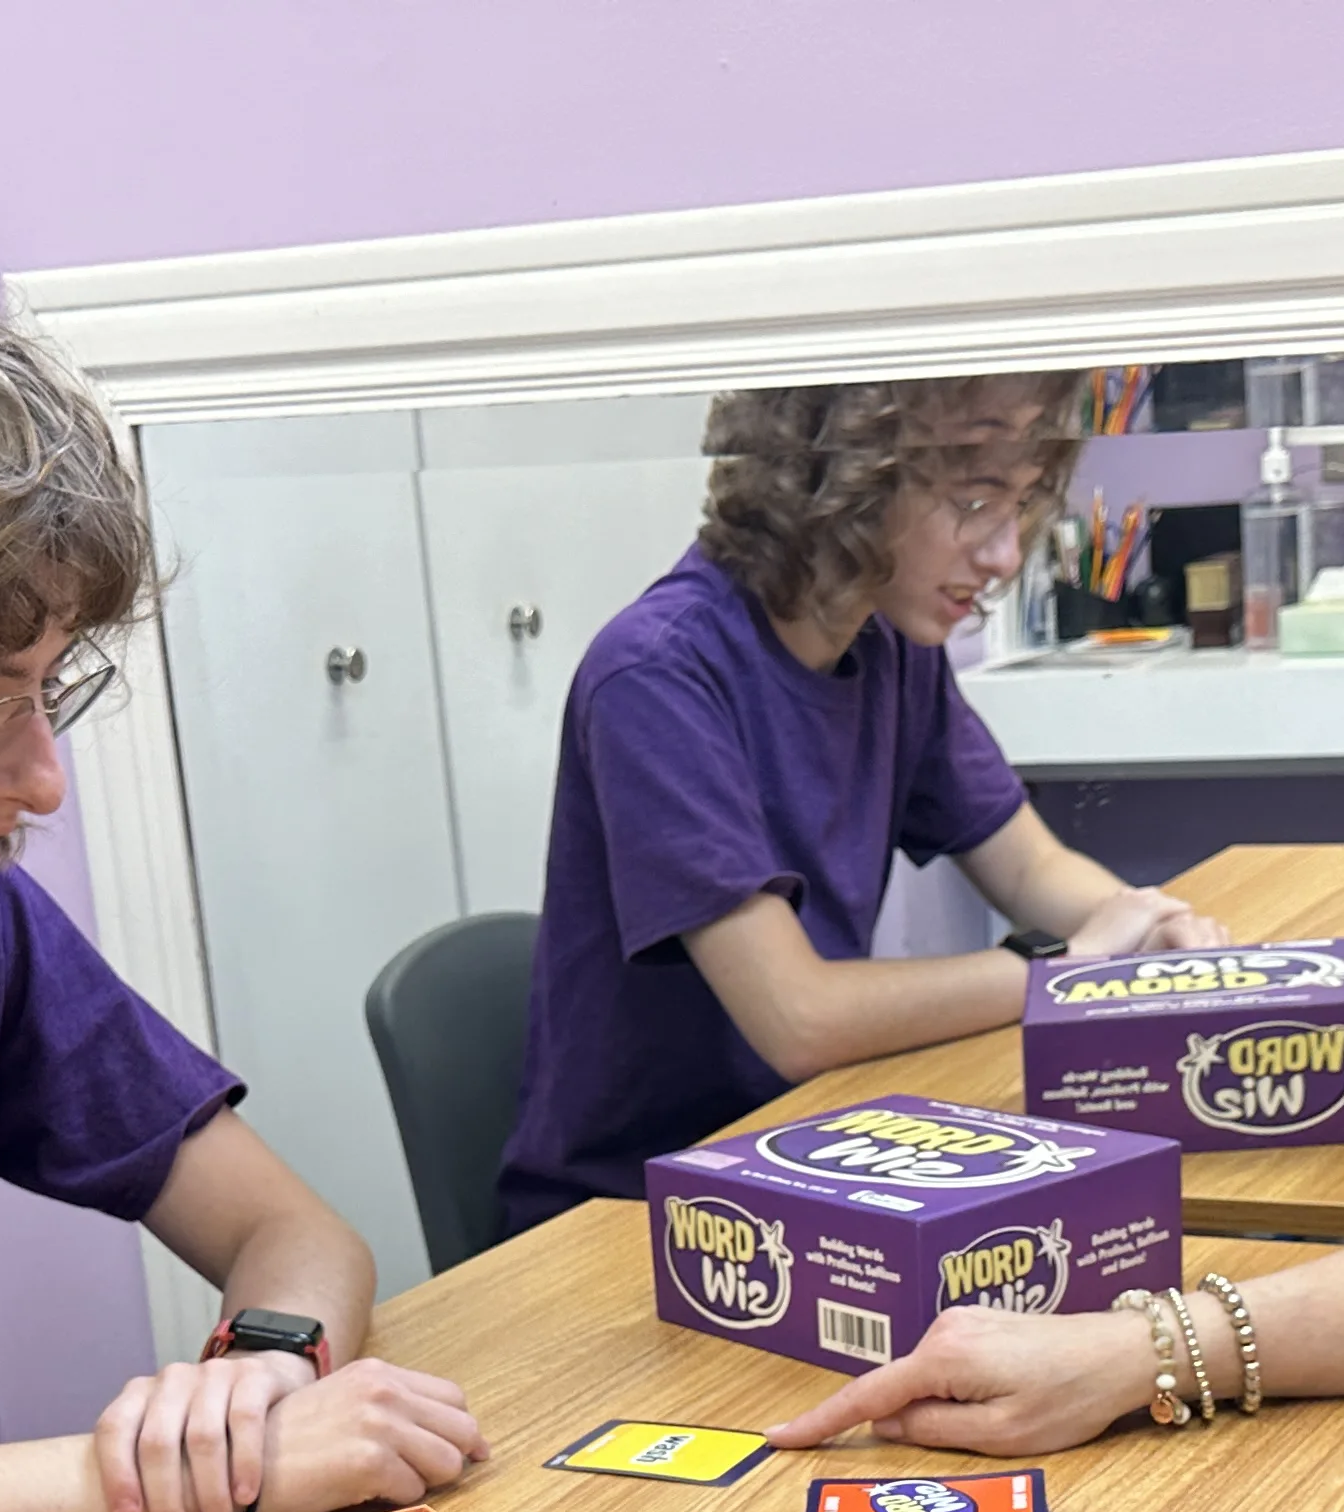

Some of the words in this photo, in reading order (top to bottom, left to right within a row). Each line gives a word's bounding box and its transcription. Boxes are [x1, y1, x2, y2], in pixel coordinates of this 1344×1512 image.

[816, 1110, 1016, 1155] WORD
[668, 1200, 754, 1263] WORD
[702, 1255, 769, 1312] Wiz
[943, 1238, 1034, 1301] WORD
[636, 1435, 689, 1463] wash
